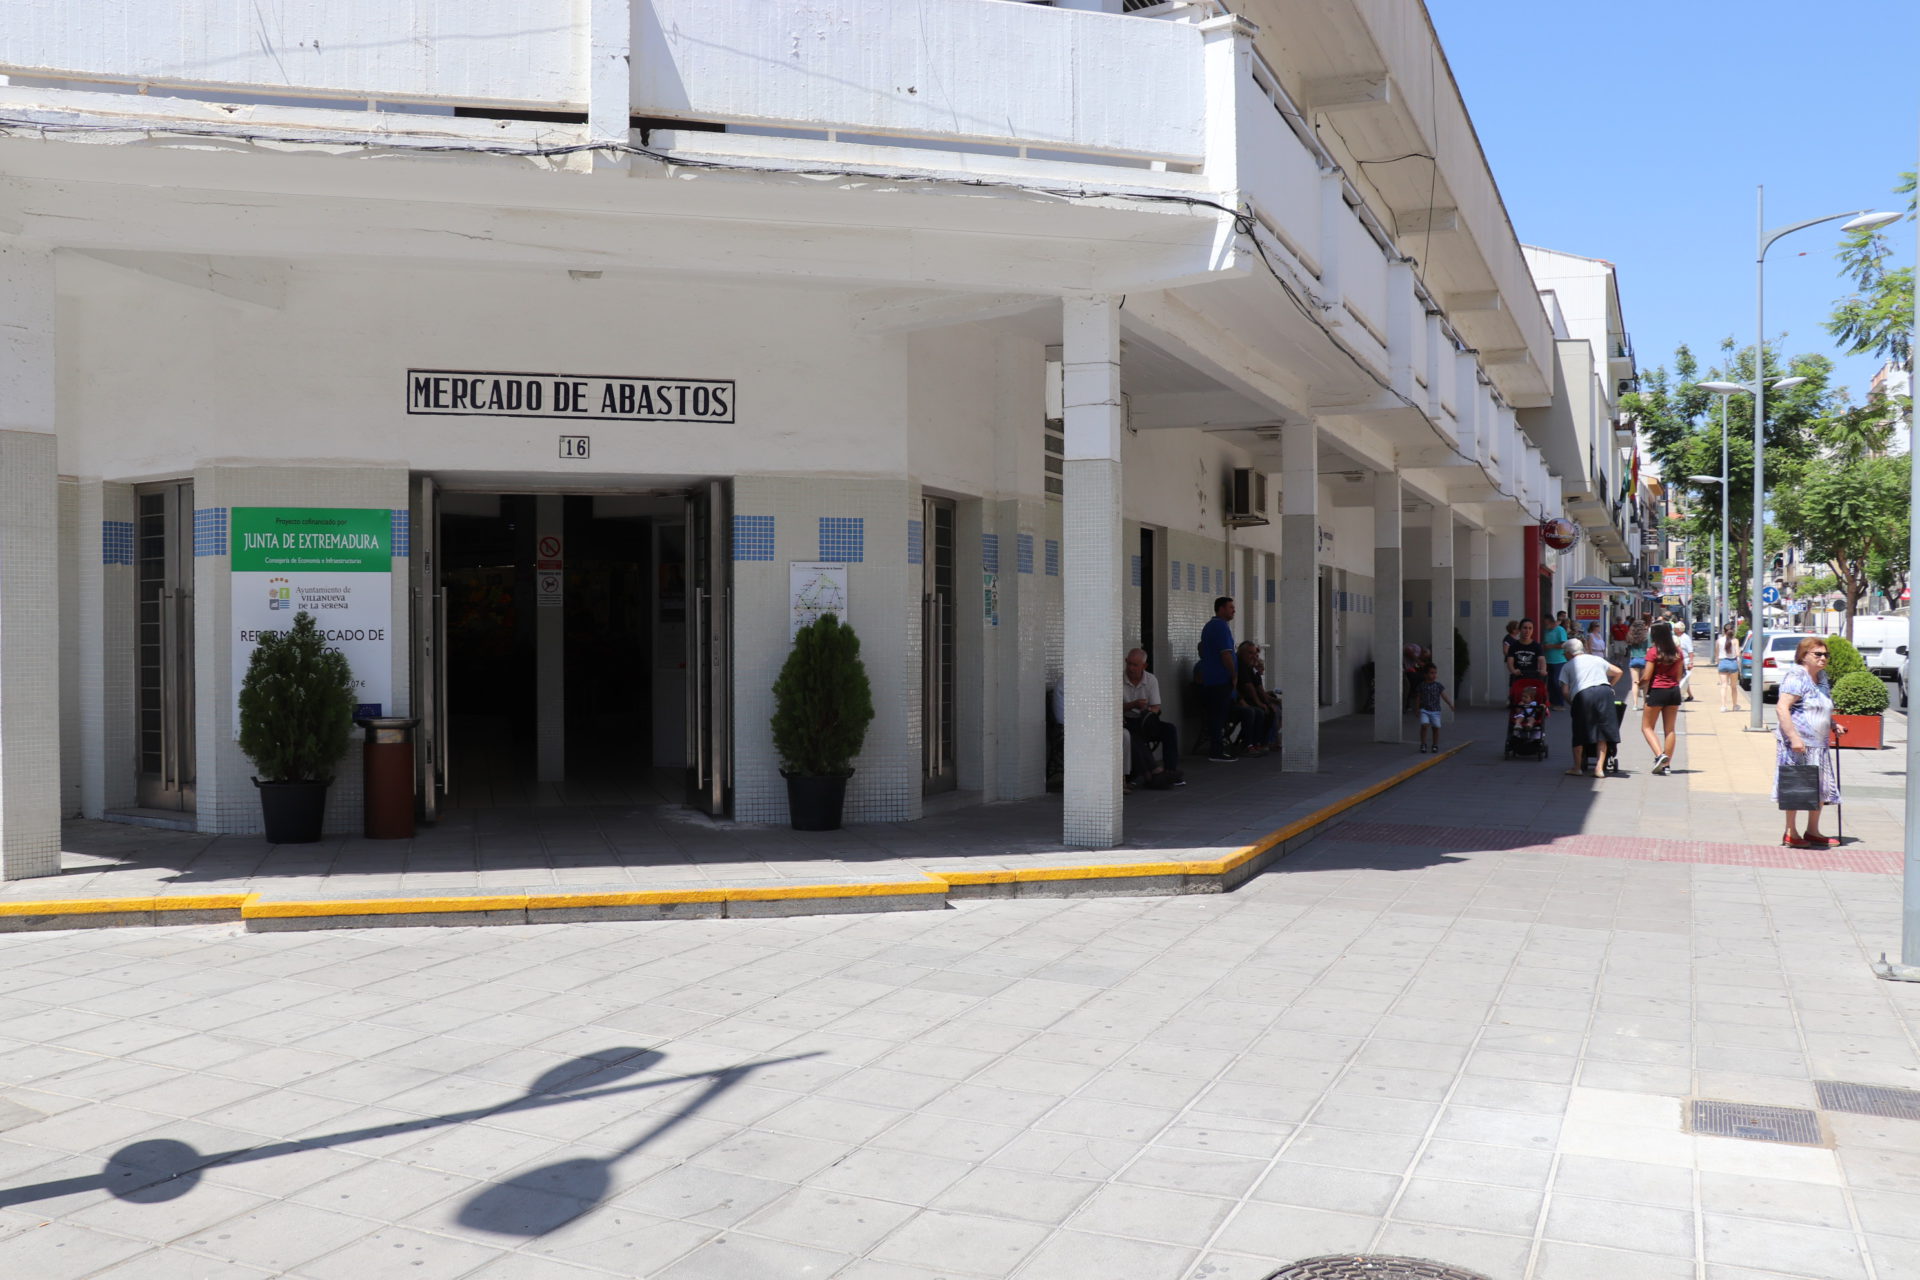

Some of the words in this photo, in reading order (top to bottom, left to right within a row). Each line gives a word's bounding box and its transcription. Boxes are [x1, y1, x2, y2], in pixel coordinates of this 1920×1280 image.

[414, 377, 542, 411] MERCADO
[553, 381, 588, 413] DE
[600, 383, 728, 417] ABASTOS
[565, 439, 586, 456] 16
[275, 517, 301, 526] Proyecto
[301, 517, 336, 525] cofinanciado
[244, 533, 280, 551] JUNTA
[282, 533, 296, 549] DE
[299, 533, 379, 549] EXTREMADURA
[296, 586, 342, 595] Ayuntamiento
[1576, 608, 1600, 616] FOTOS
[312, 629, 365, 641] ERCADO
[368, 629, 385, 641] DE
